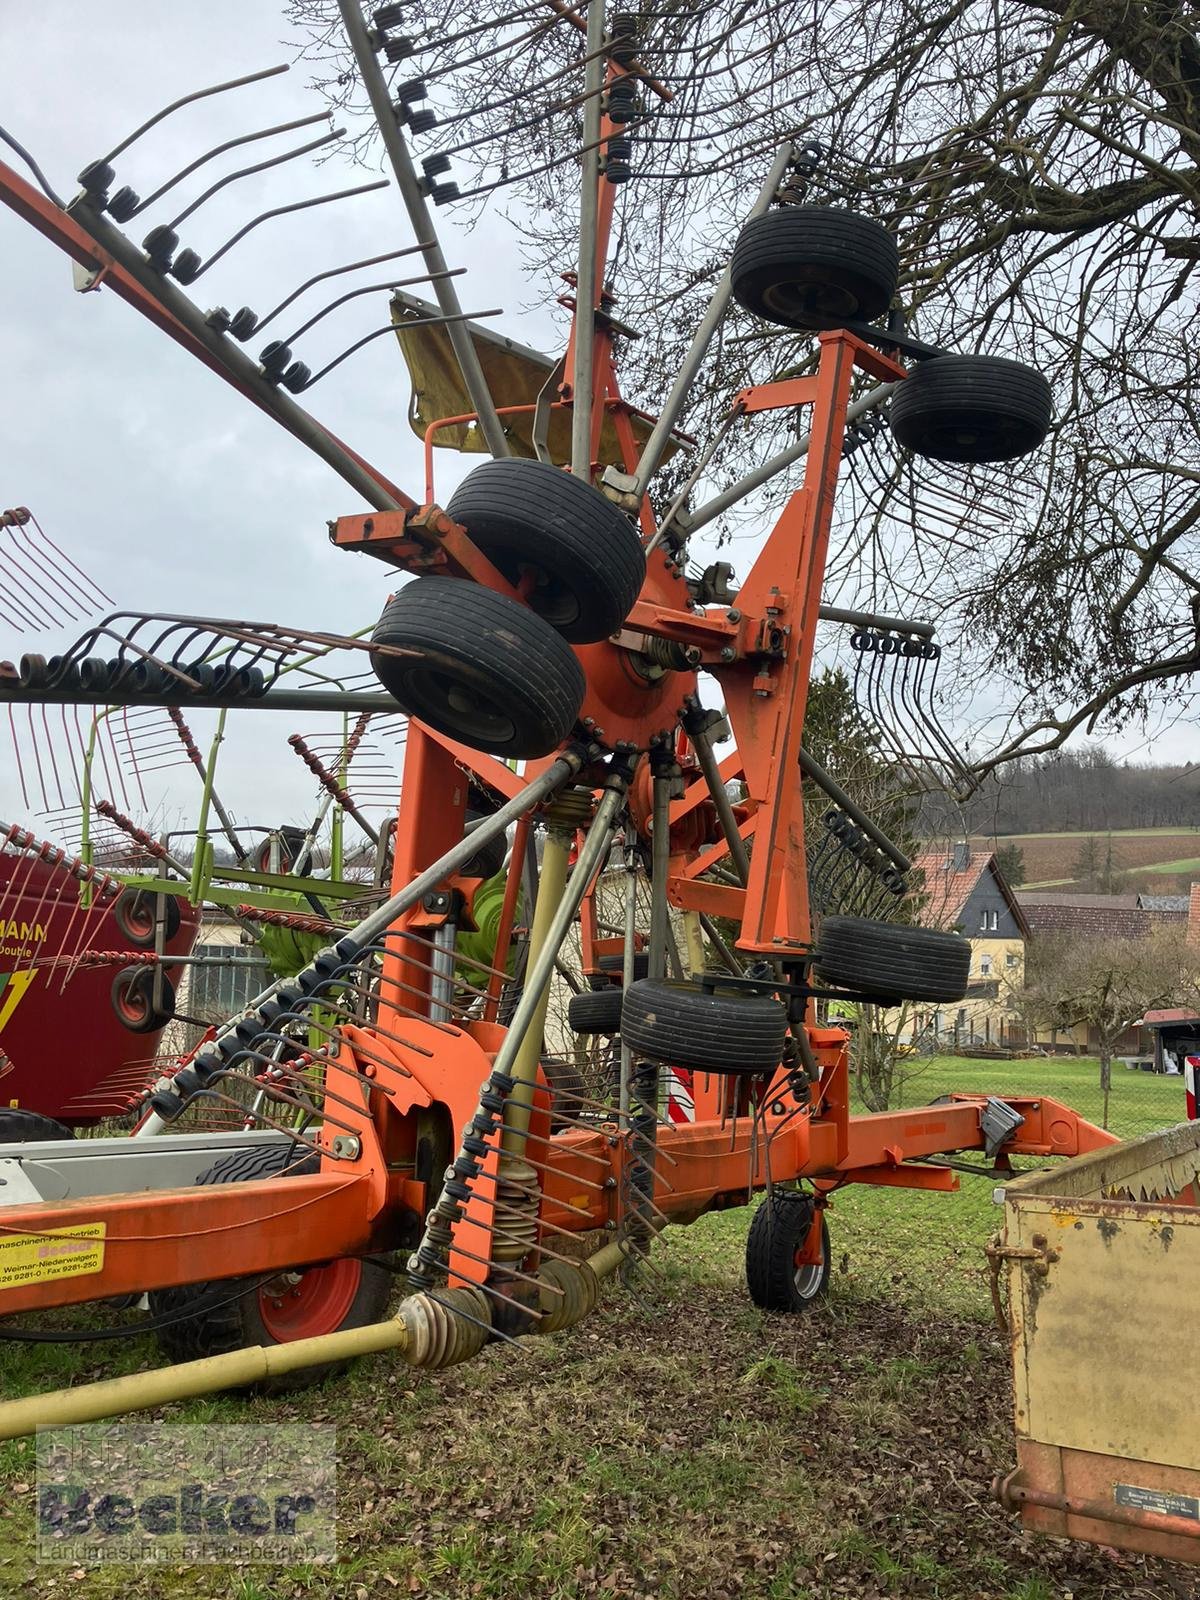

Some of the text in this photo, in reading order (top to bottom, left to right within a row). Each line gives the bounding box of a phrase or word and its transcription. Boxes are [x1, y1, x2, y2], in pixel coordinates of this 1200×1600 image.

[0, 1261, 98, 1283] 26 9281-0 Fax 9281-250
[3, 1253, 98, 1273] Weimar-Niederwalgern
